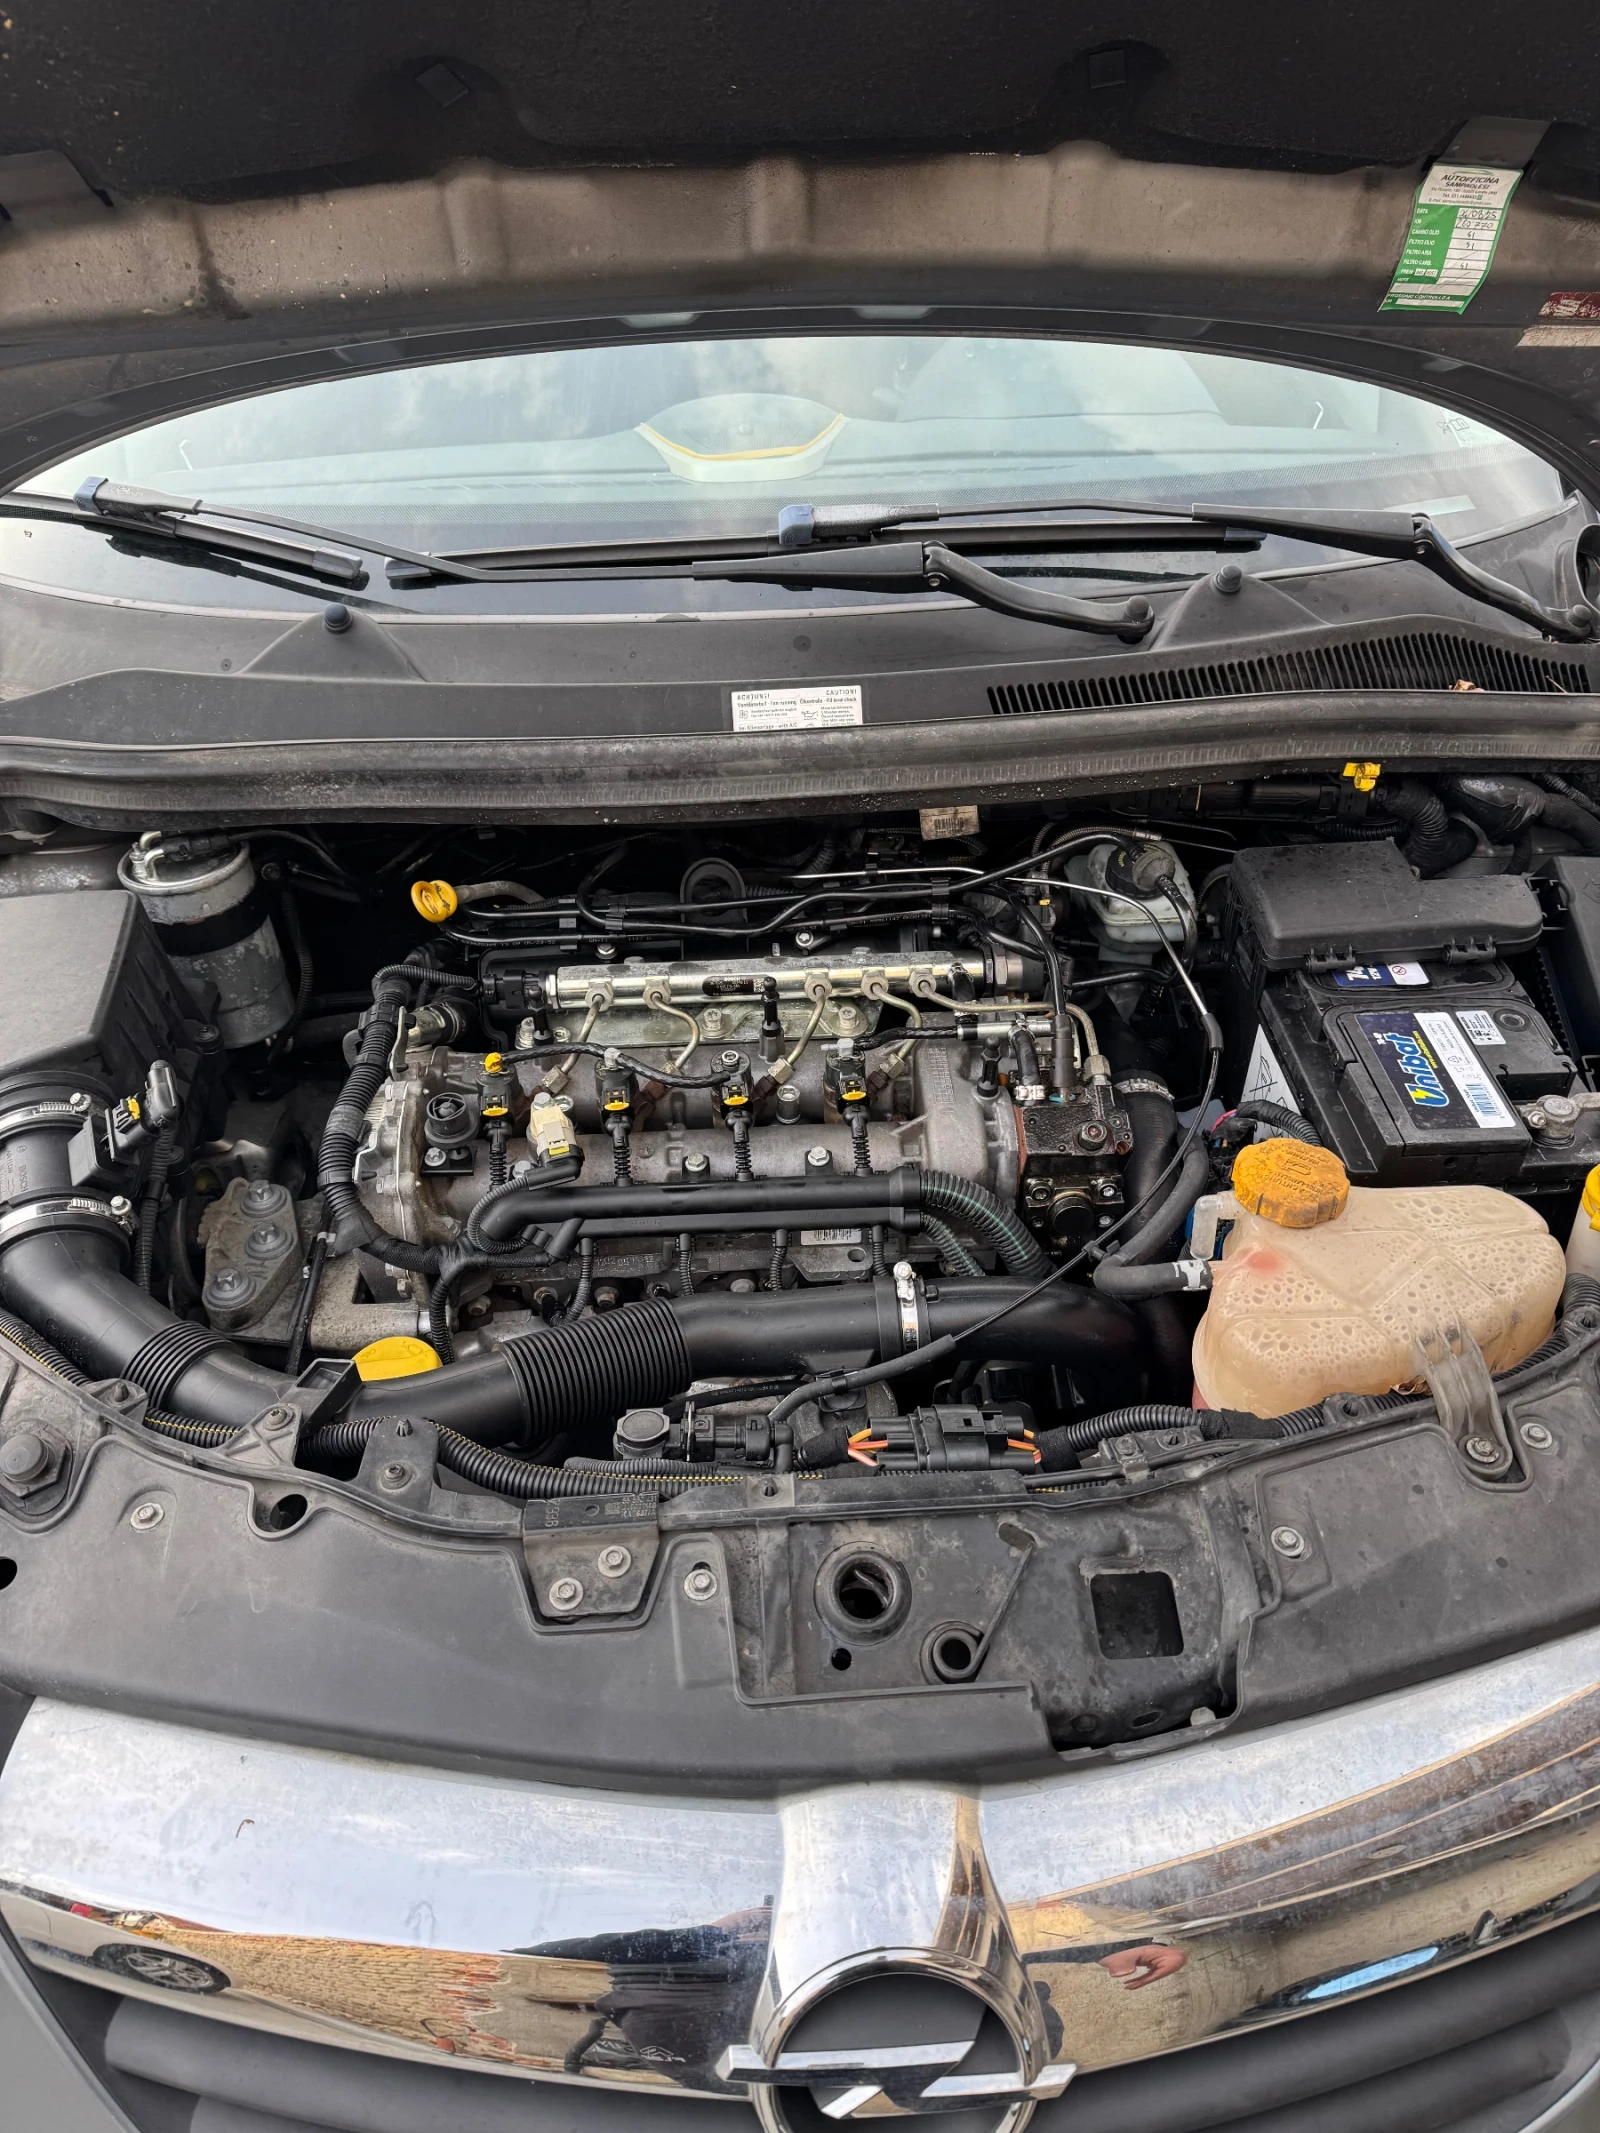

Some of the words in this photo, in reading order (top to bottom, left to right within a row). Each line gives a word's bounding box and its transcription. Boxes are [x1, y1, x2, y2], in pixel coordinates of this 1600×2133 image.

[1441, 174, 1500, 184] AUTOFFICINA
[1445, 182, 1491, 190] SAMPAOLESI
[1383, 1032, 1450, 1108] Unibat
[19, 1164, 29, 1192] BOSCH
